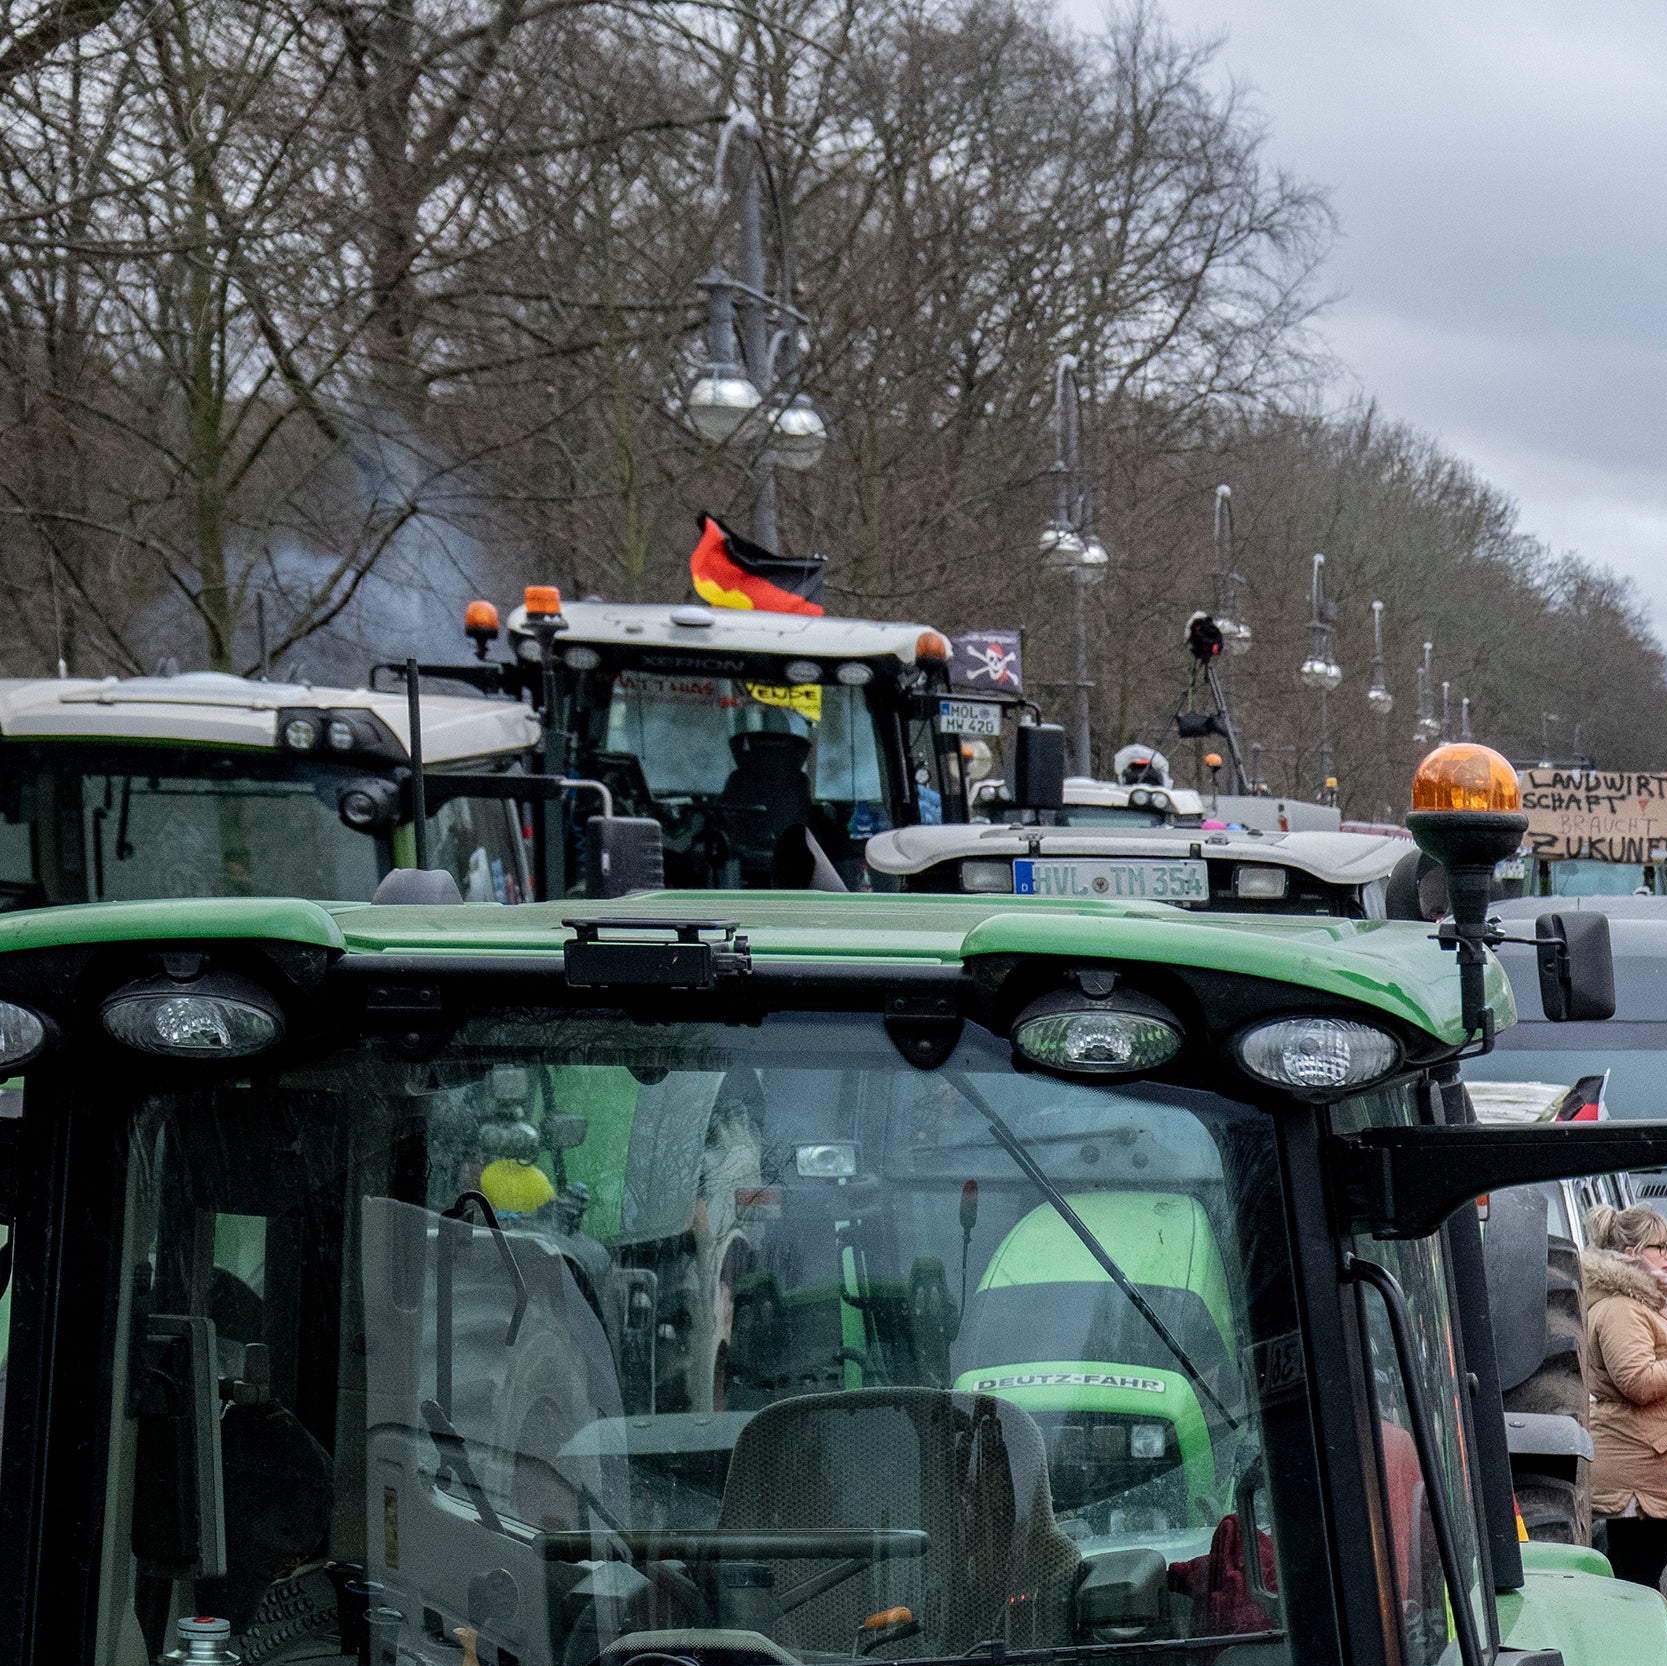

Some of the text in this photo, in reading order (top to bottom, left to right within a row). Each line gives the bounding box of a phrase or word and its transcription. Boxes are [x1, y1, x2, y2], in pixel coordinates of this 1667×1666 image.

[1523, 793, 1626, 815] SCHAFT
[1560, 814, 1659, 838] BRAUCHT
[1021, 866, 1203, 896] D HVL TM 354
[977, 1373, 1160, 1392] DEUTZ-FAHR
